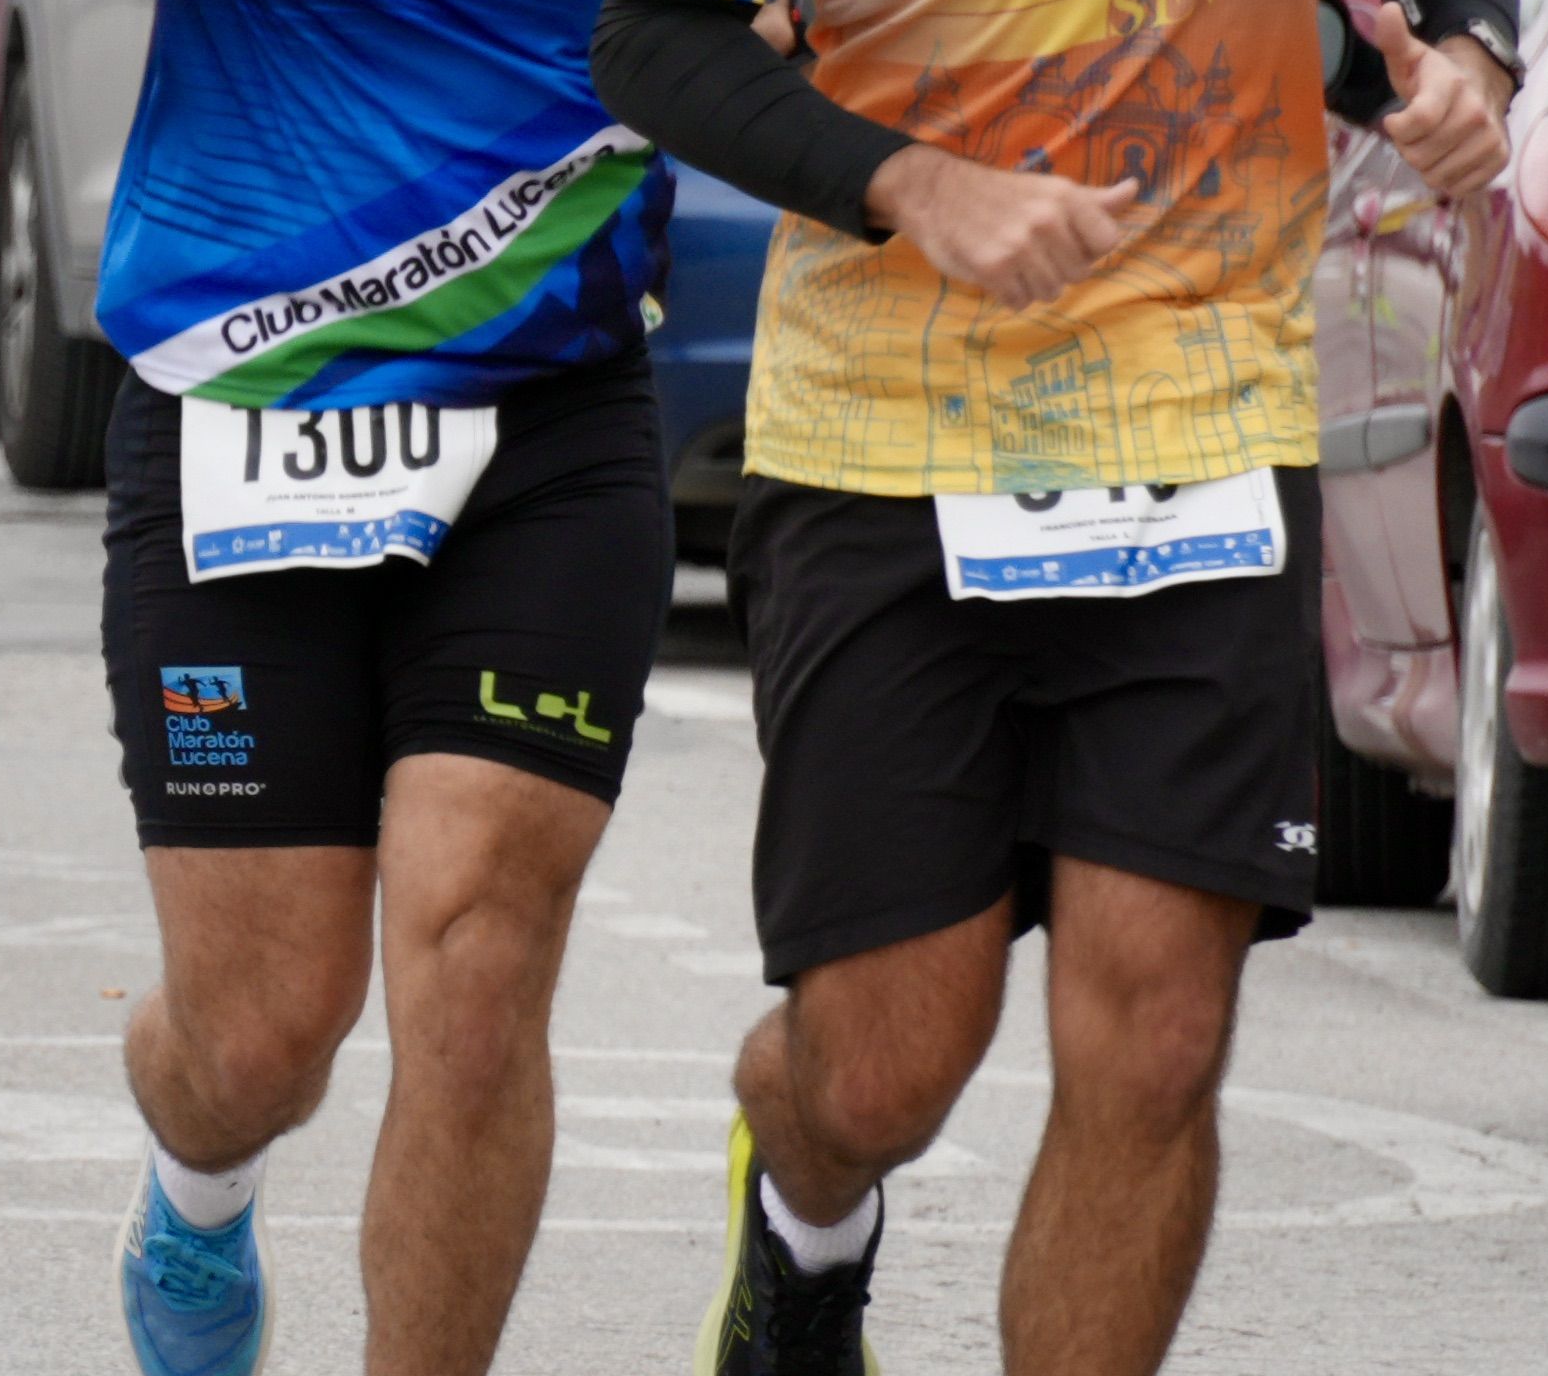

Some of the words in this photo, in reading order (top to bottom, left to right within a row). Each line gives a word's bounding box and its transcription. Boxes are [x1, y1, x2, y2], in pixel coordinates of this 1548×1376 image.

[220, 296, 323, 355] Club
[320, 229, 491, 315] Maratón
[166, 714, 211, 732] Club
[168, 730, 256, 749] Maratón
[170, 748, 249, 765] Lucena
